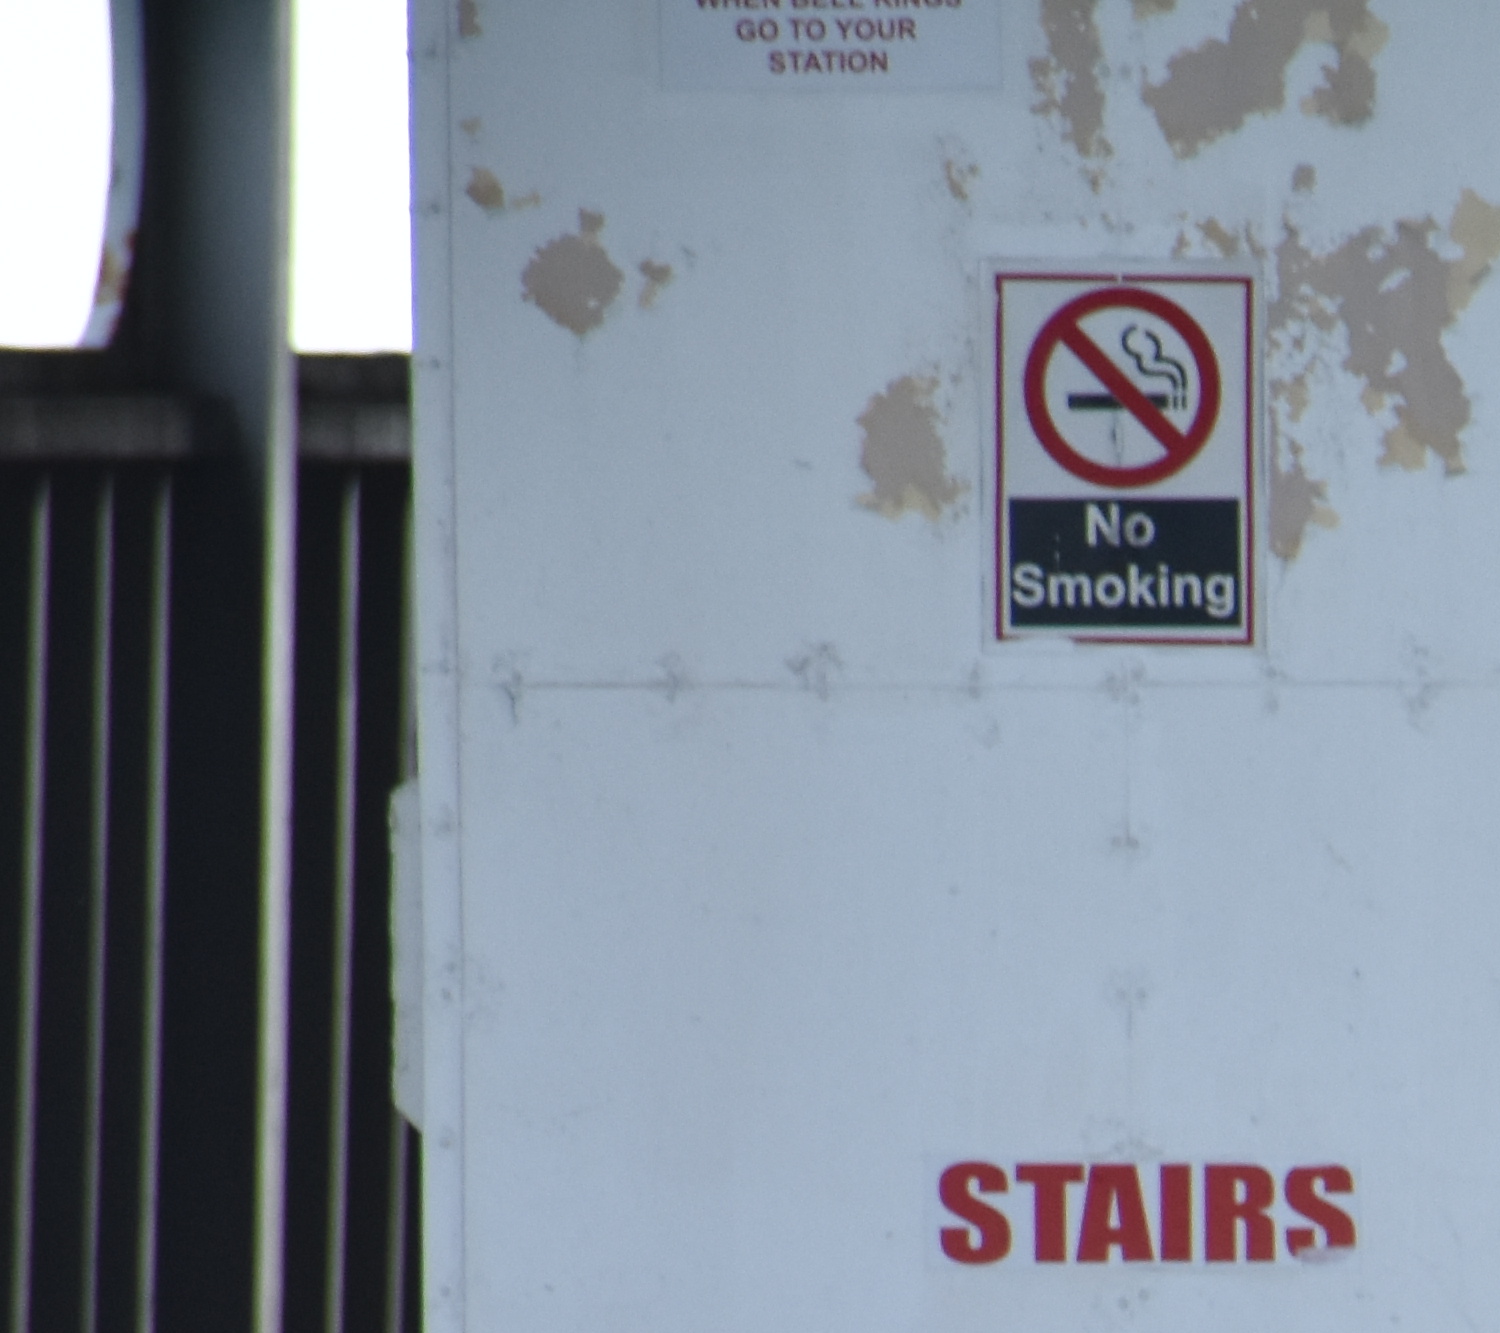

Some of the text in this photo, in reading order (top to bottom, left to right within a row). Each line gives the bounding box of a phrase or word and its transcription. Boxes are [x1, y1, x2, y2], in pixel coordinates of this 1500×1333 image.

[735, 17, 917, 42] GO TO YOUR
[767, 50, 889, 75] STATION
[1085, 502, 1157, 548] No
[1011, 561, 1236, 619] Smoking
[938, 1161, 1357, 1265] STAIRS
